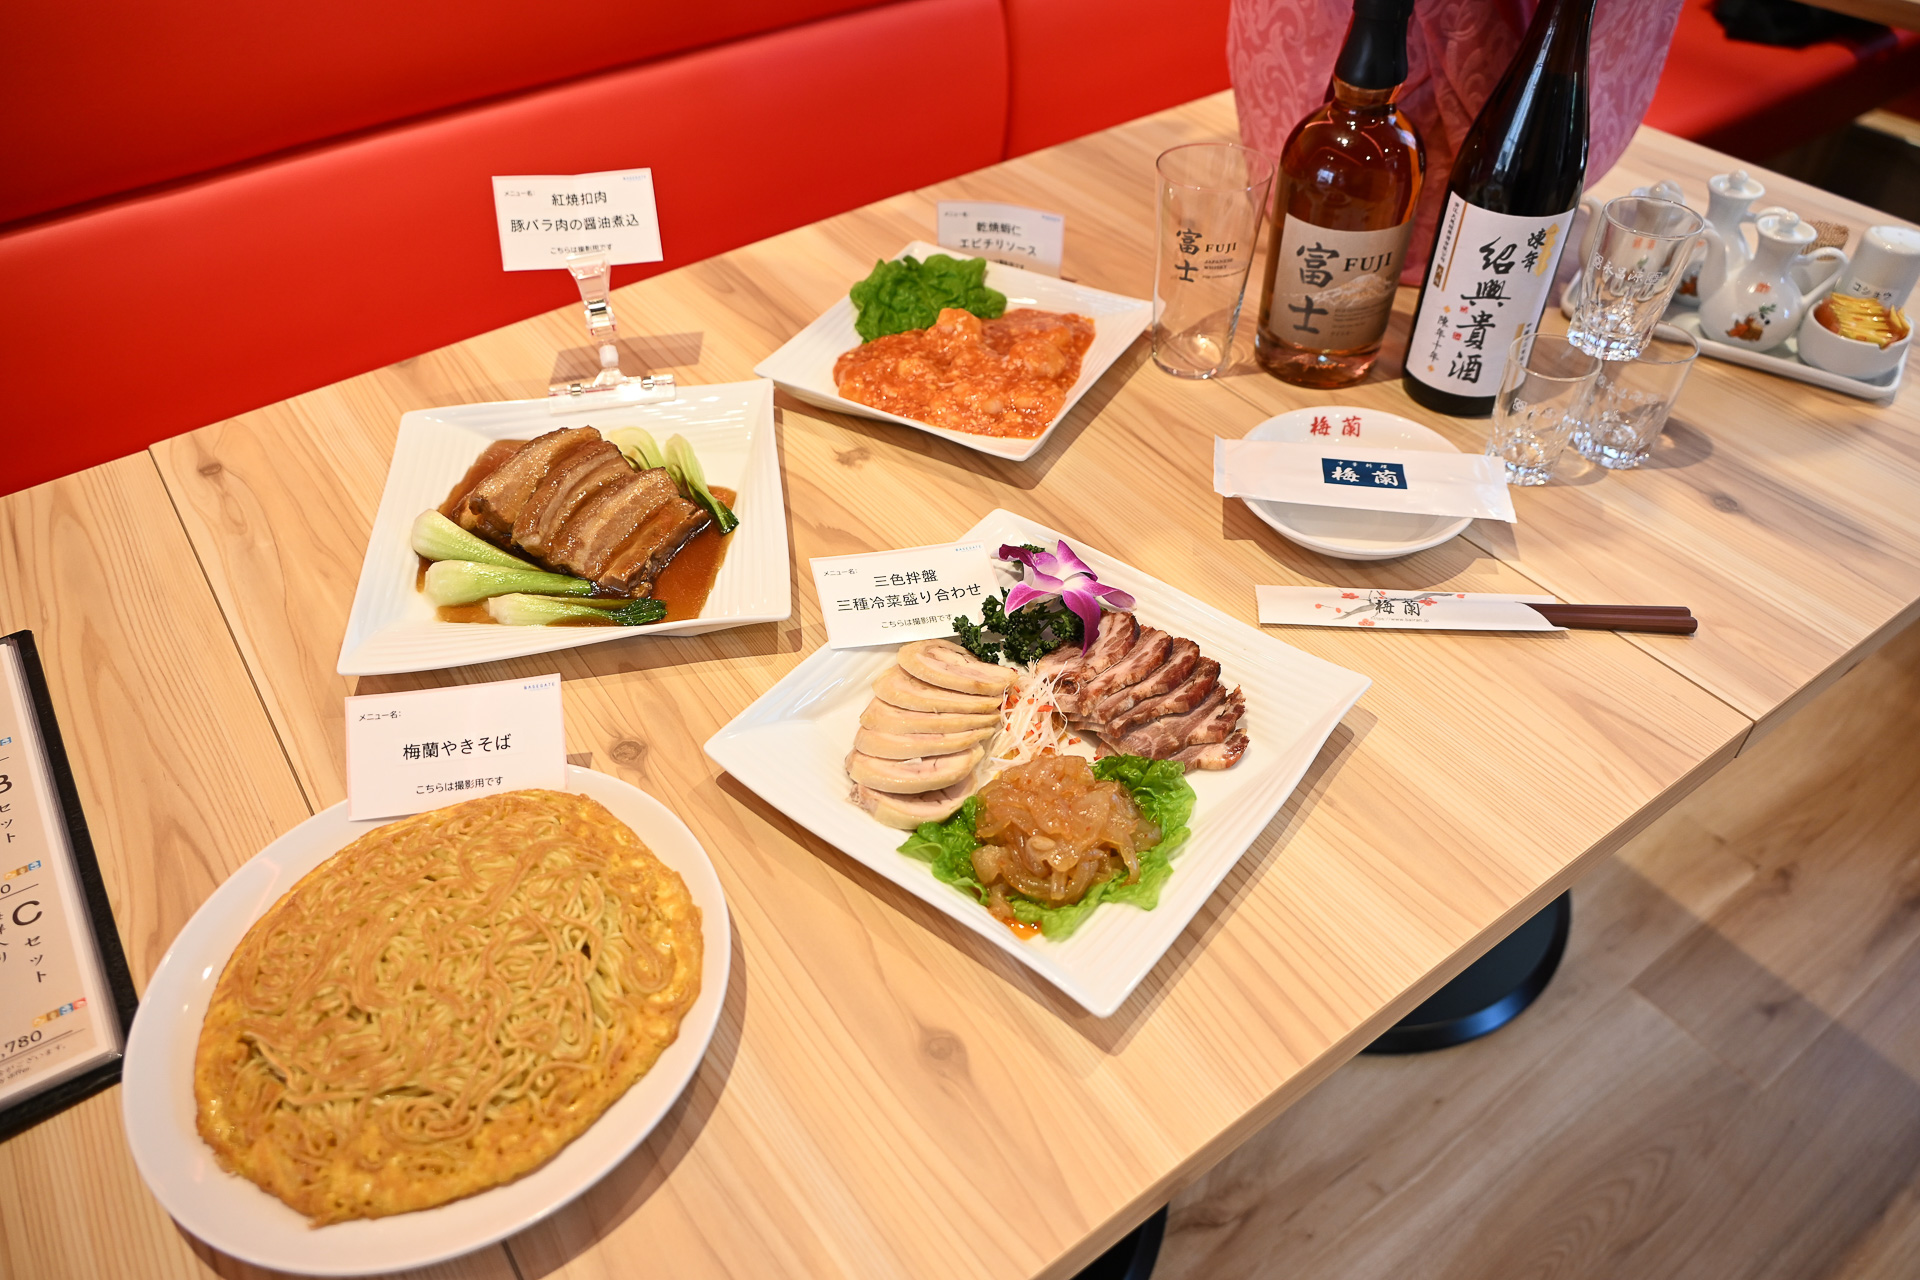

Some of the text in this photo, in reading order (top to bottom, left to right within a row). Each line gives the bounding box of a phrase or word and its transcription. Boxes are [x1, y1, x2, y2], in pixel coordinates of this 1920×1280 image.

[551, 191, 607, 206] 紅焼扣肉
[511, 214, 640, 233] 豚バラ肉の醤油煮込
[959, 238, 1037, 257] エビチリソース
[1174, 228, 1203, 283] 富士
[1205, 242, 1237, 254] FUJI
[1343, 252, 1394, 273] FUJI
[1288, 242, 1340, 335] 富士
[873, 569, 939, 588] 三色拌盤
[836, 583, 982, 612] 三種冷菜盛り合わせ
[881, 614, 953, 629] こちらは撮影用です
[359, 710, 402, 722] メニュー名:
[402, 733, 512, 760] 梅蘭やきそば
[416, 776, 504, 795] こちらは撮影用です
[12, 900, 47, 983] C セット
